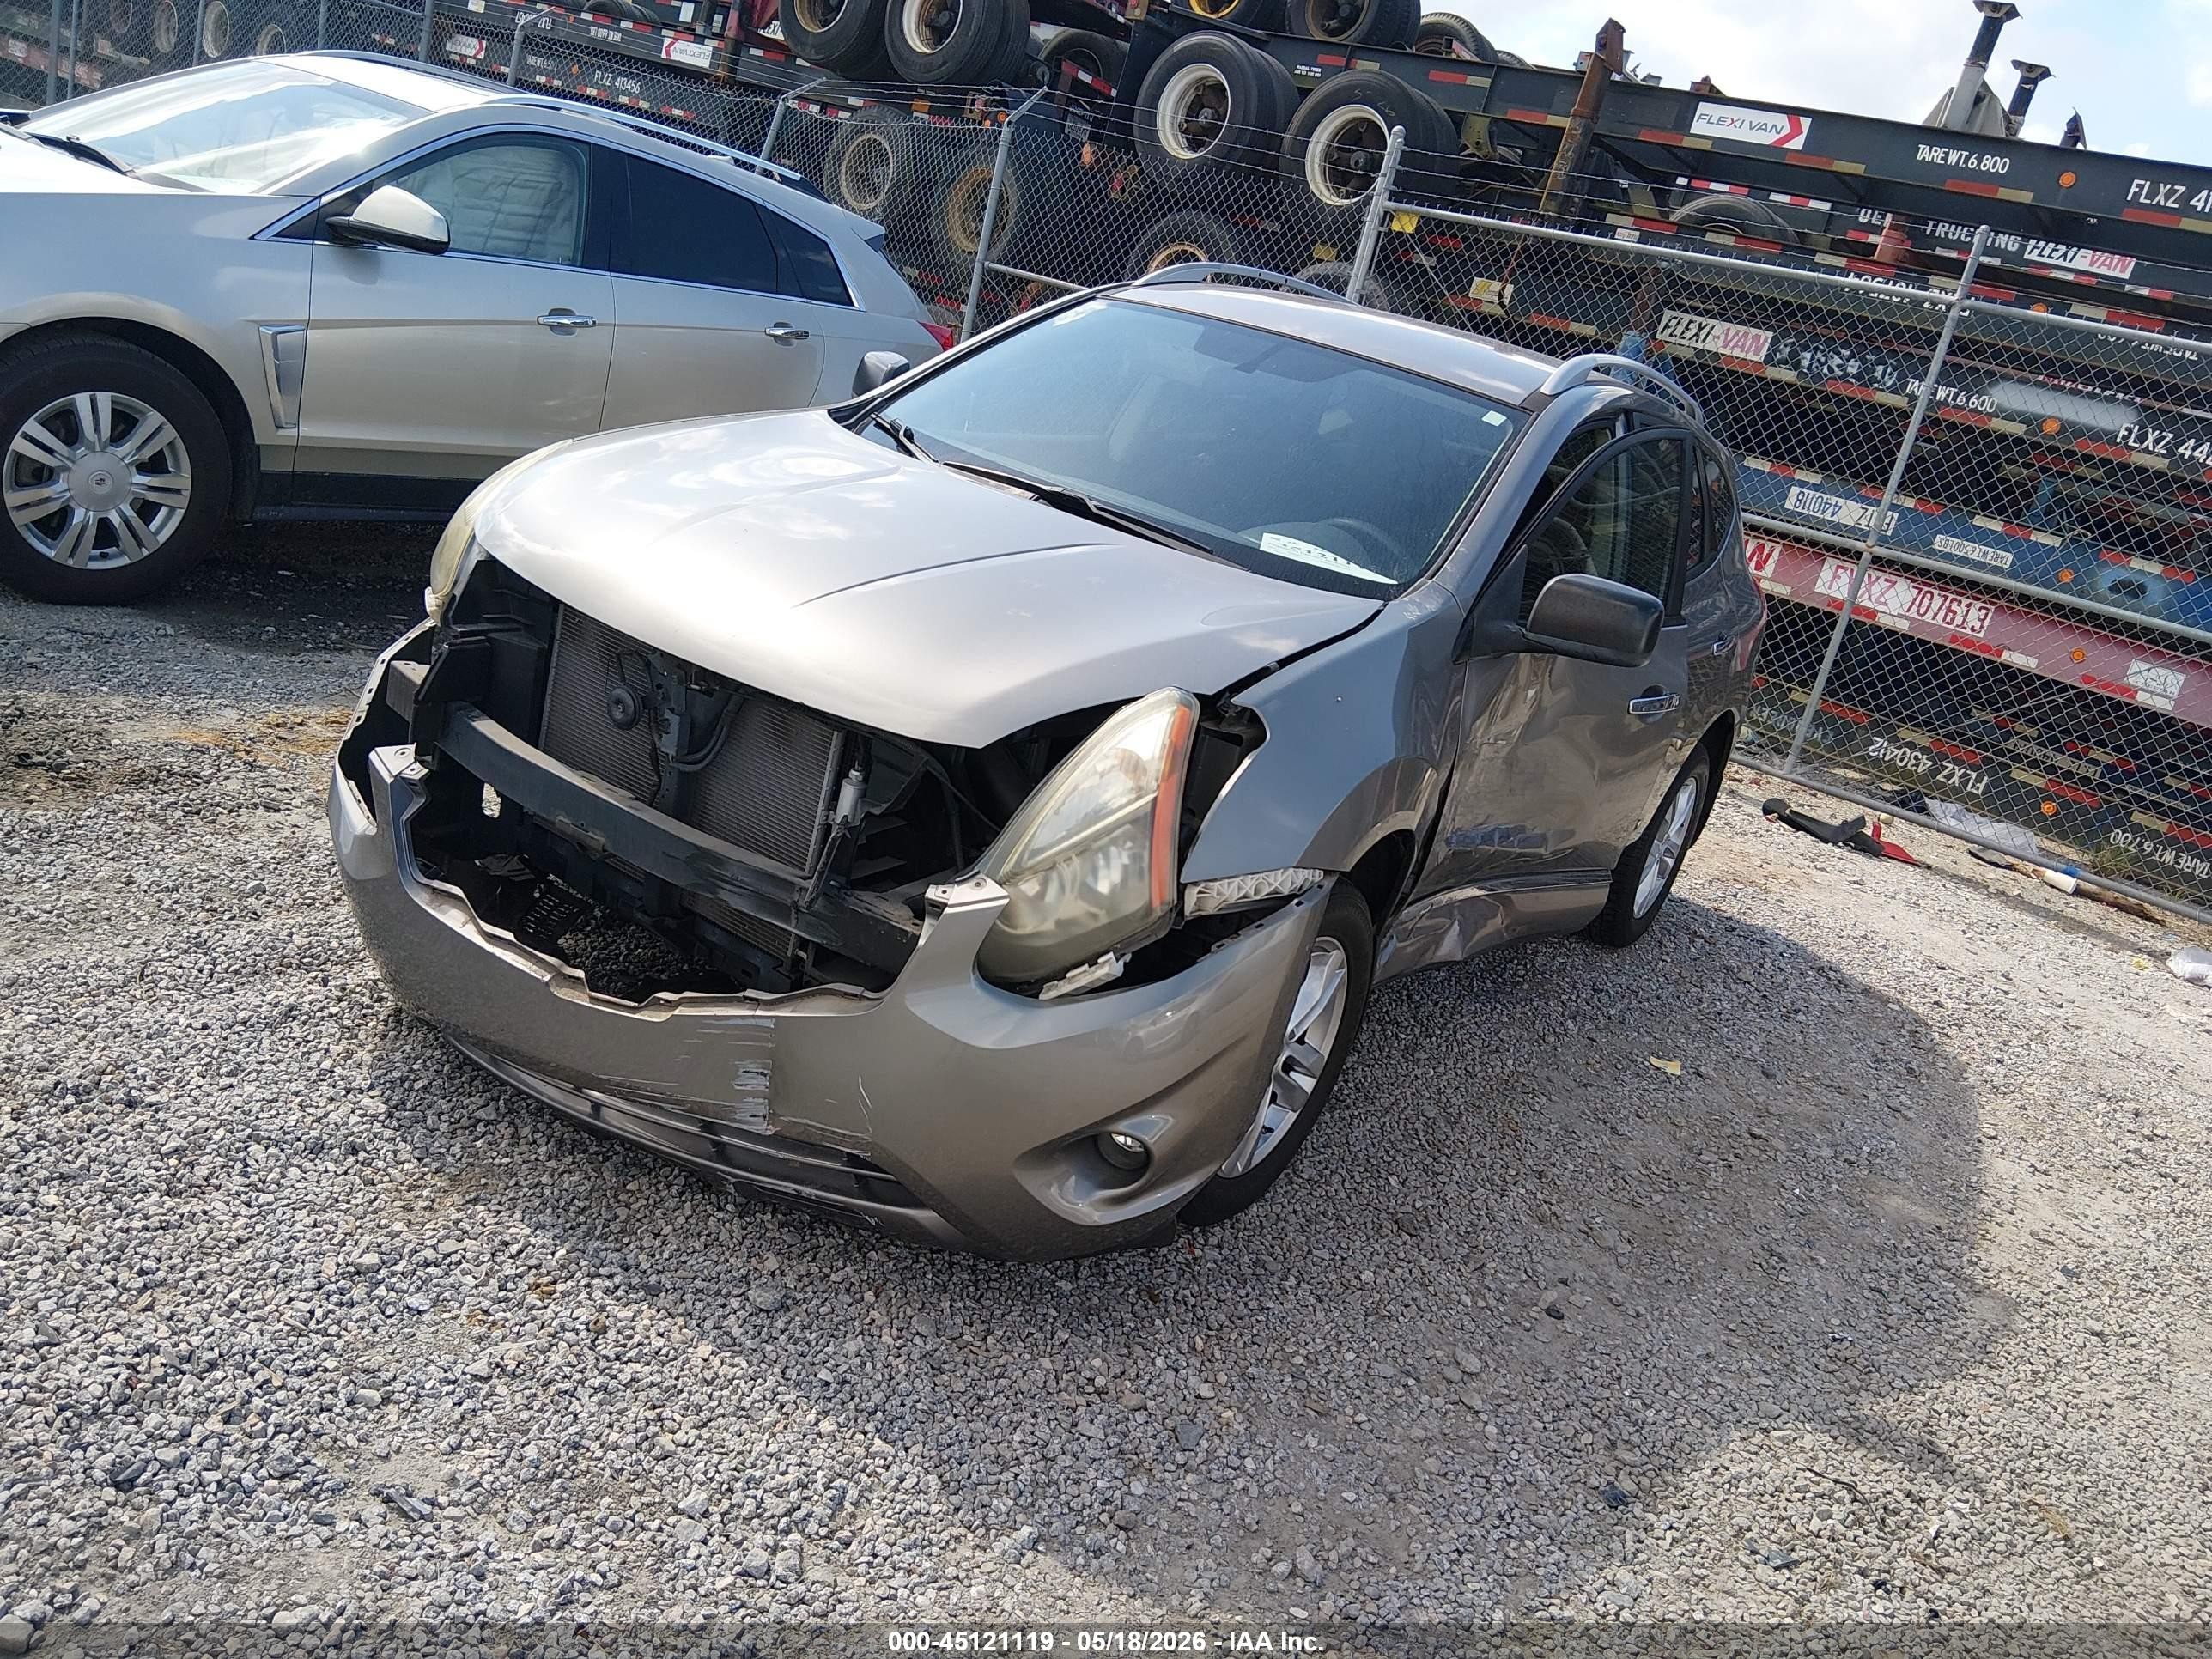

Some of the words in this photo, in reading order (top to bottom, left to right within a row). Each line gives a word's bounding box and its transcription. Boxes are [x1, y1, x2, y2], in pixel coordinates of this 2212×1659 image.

[593, 70, 612, 86] FLXZ
[614, 76, 641, 94] 413456
[1696, 113, 1742, 130] FLEXI
[1747, 119, 1785, 136] VAN
[2126, 179, 2186, 209] FLXZ
[2116, 422, 2174, 454] FLXZ
[1793, 490, 1843, 518] 440118
[1905, 586, 1990, 635] 707613
[1933, 761, 1988, 794] FLXZ
